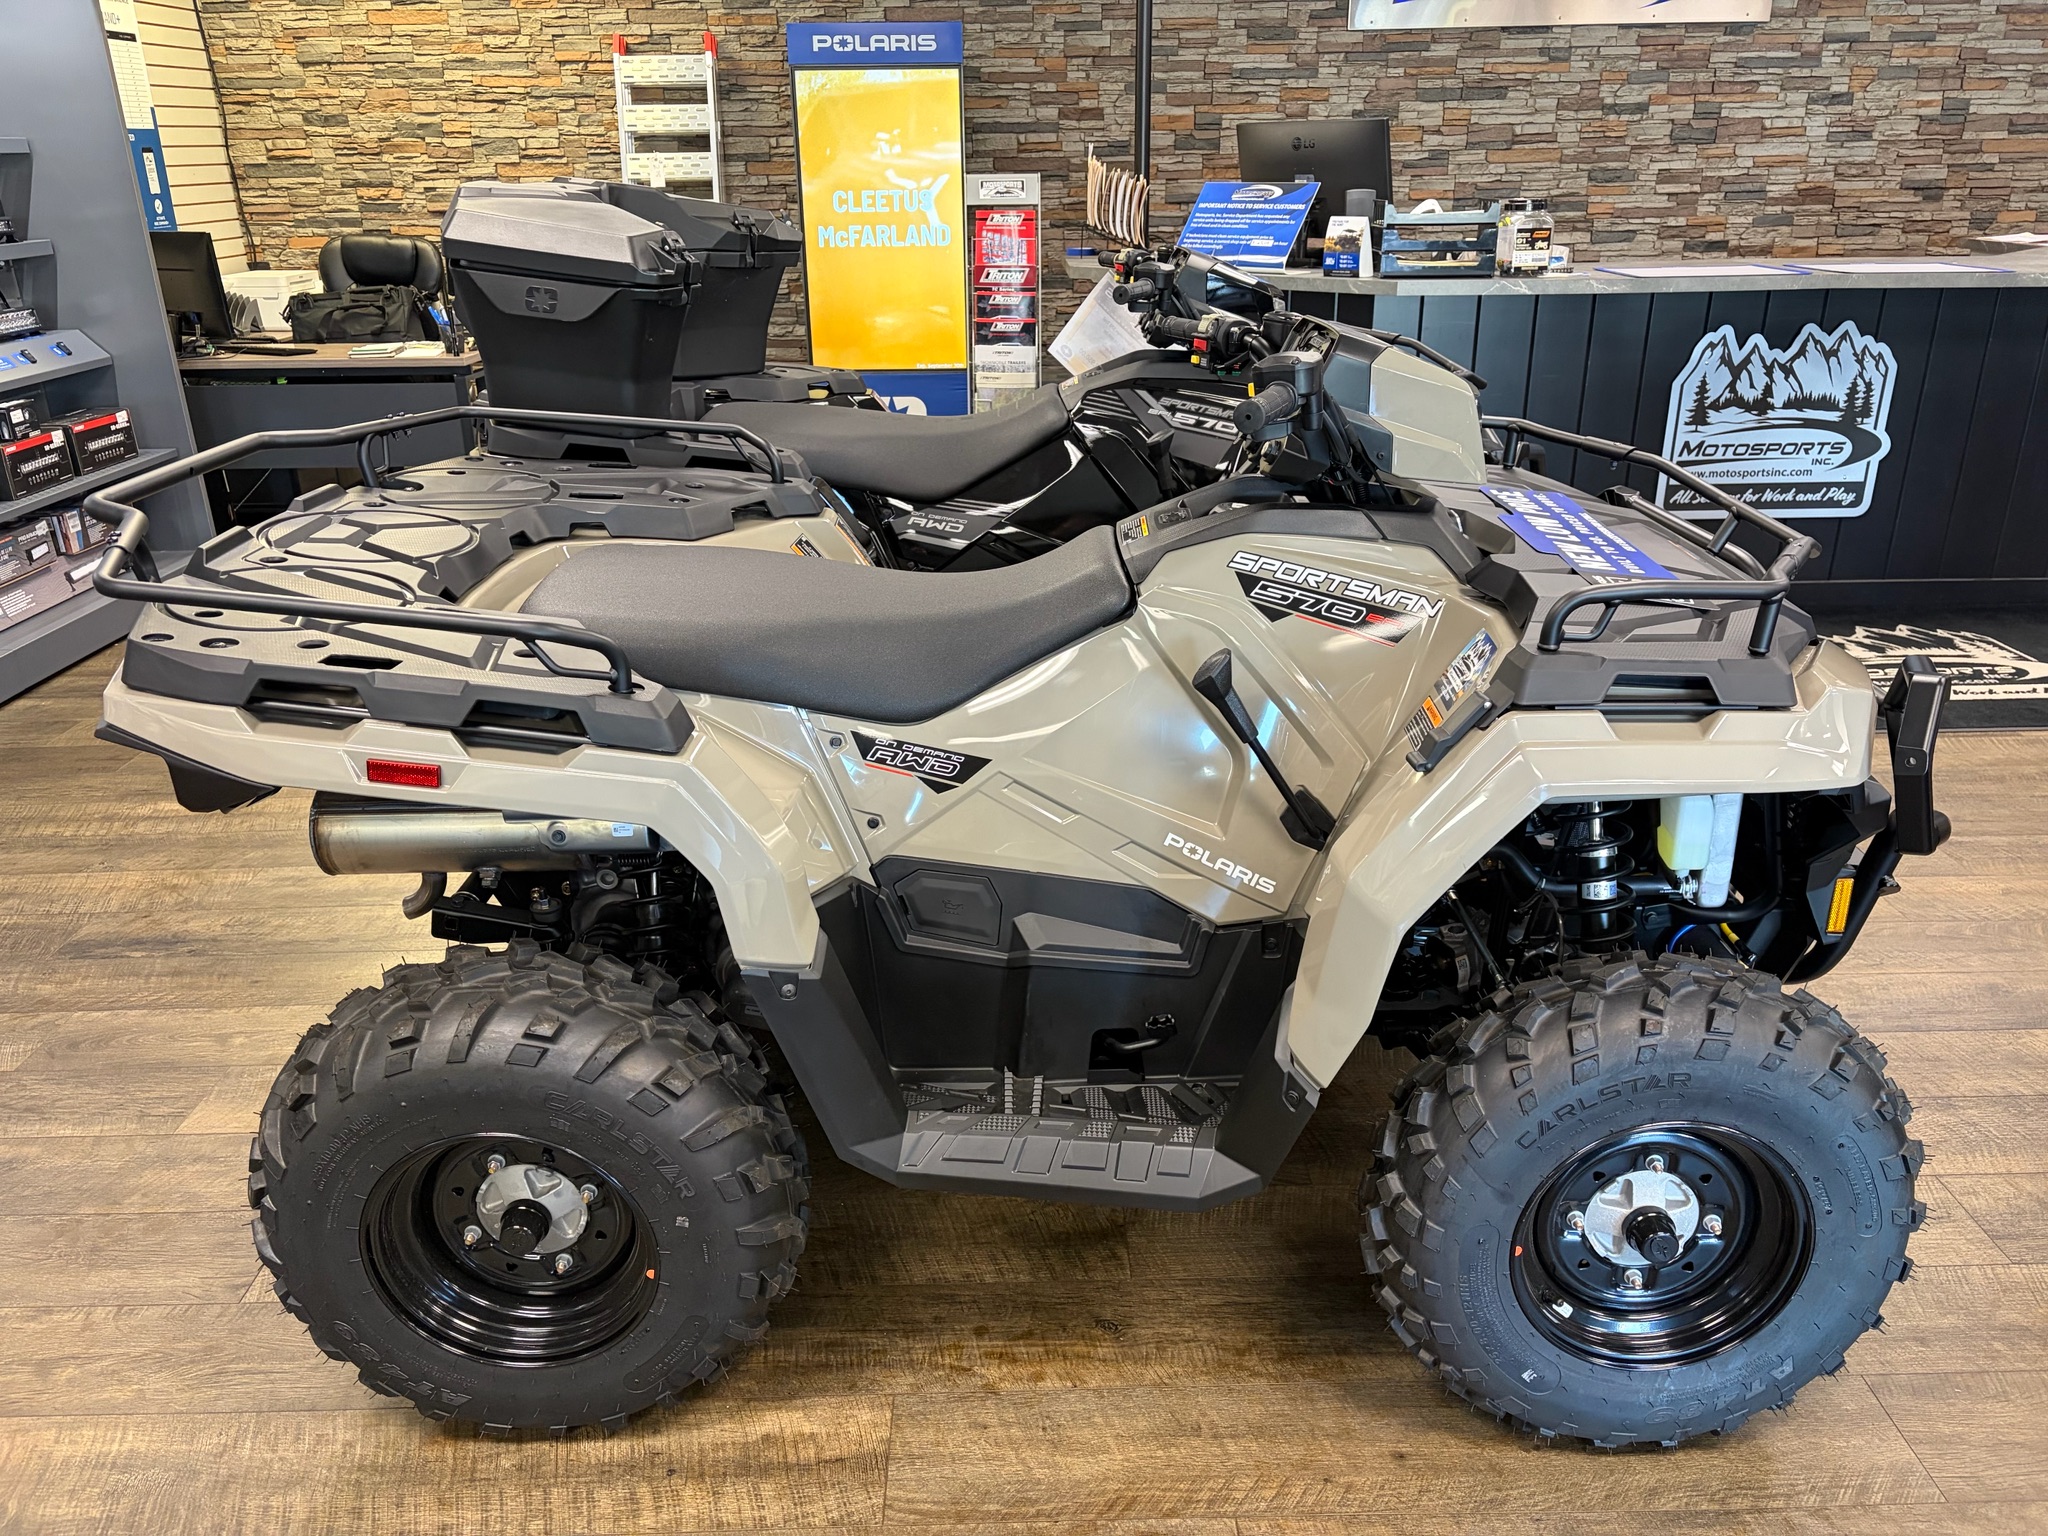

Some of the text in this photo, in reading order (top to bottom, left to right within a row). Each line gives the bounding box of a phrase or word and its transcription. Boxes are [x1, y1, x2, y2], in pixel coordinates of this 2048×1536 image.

[812, 34, 937, 52] POLARIS
[1303, 138, 1316, 149] LG
[832, 189, 933, 213] CLEETUS
[991, 214, 1020, 223] TRITON
[817, 224, 951, 248] McFARLAND
[986, 269, 1023, 280] TRITON
[993, 294, 1019, 303] TRITON
[995, 322, 1020, 330] TRITON
[1157, 396, 1234, 419] SPORTSMA
[1172, 412, 1239, 434] 570
[1677, 440, 1847, 458] MOTOSPORTS
[1811, 457, 1835, 466] INC.
[1690, 467, 1813, 480] w.motosportsinc.com
[1669, 489, 1695, 505] All
[1740, 488, 1761, 503] for
[1760, 487, 1796, 503] Work
[1797, 487, 1823, 502] and
[1822, 486, 1857, 506] Play
[907, 516, 966, 533] AWD
[928, 513, 968, 524] DEMAND
[1523, 514, 1581, 542] LOW
[1552, 540, 1618, 571] NEW
[1226, 550, 1447, 618] SPORTSMAN
[1249, 580, 1367, 624] 570
[866, 745, 961, 777] AWD
[875, 738, 966, 763] ON DEMAND
[1163, 832, 1277, 894] POLARIS
[1515, 1072, 1692, 1150] CARLSTAR
[544, 1090, 697, 1200] CARLSTAR
